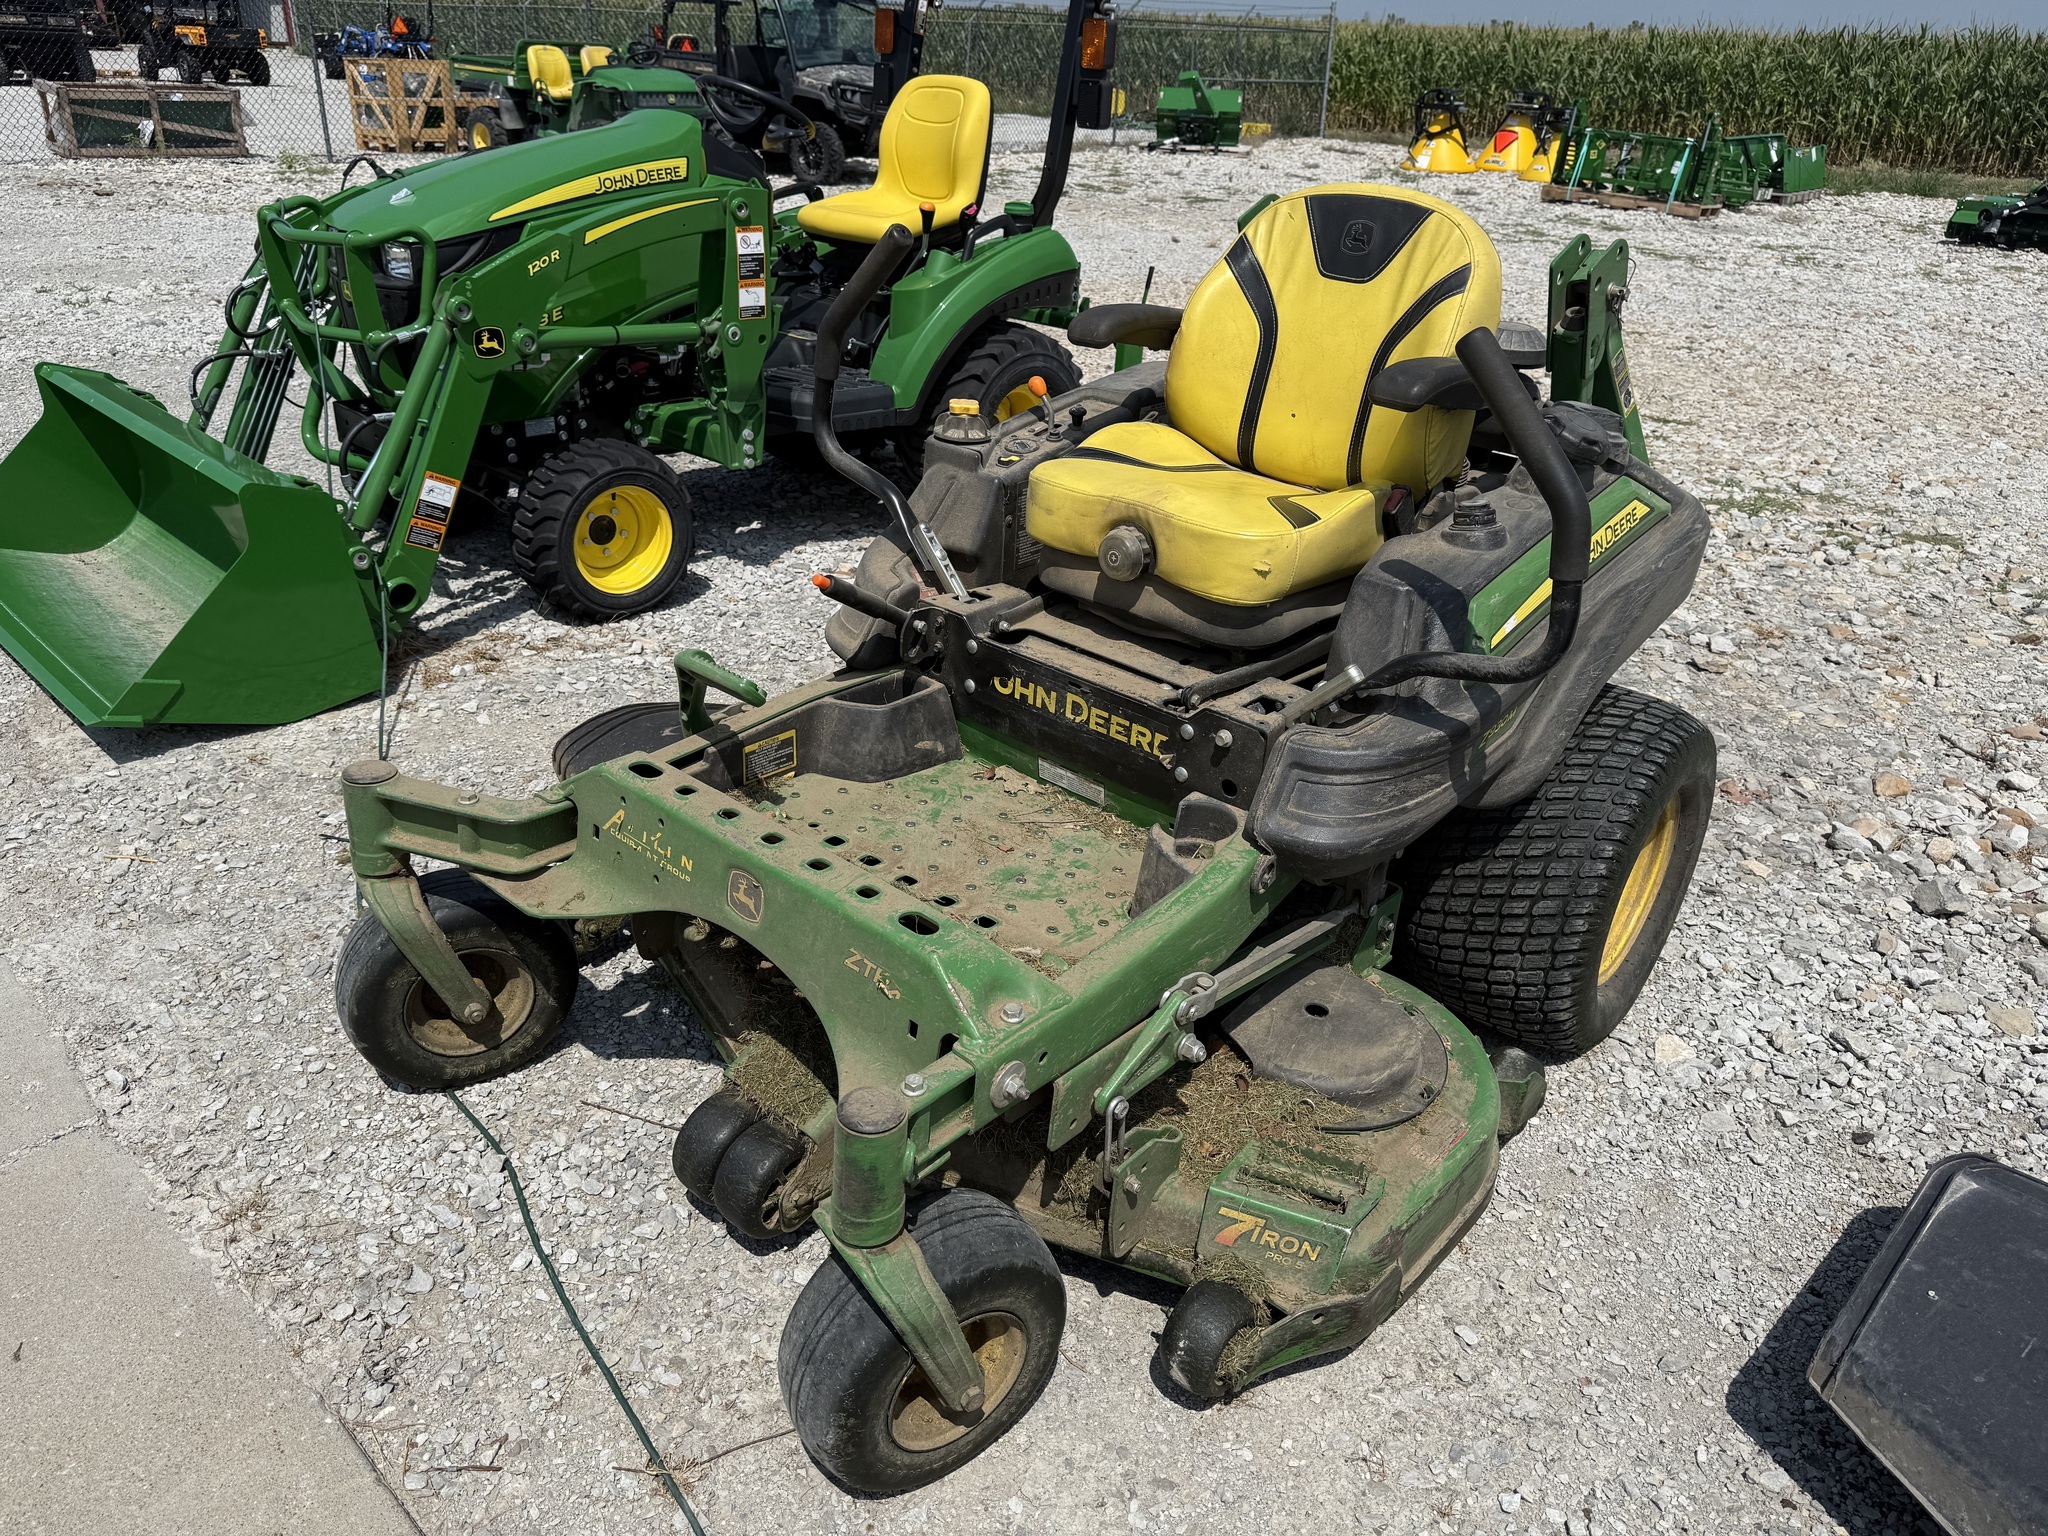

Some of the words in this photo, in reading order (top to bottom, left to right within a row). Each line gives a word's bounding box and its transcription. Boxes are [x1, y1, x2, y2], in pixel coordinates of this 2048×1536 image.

[595, 173, 634, 192] JOHN
[636, 166, 682, 184] DEERE
[434, 475, 456, 486] WARNING
[420, 522, 442, 532] WARNING
[1605, 506, 1639, 546] DEERE
[993, 676, 1057, 715] OHN
[1214, 1206, 1267, 1247] 7
[1250, 1226, 1322, 1262] IRON
[1264, 1251, 1292, 1265] PRO
